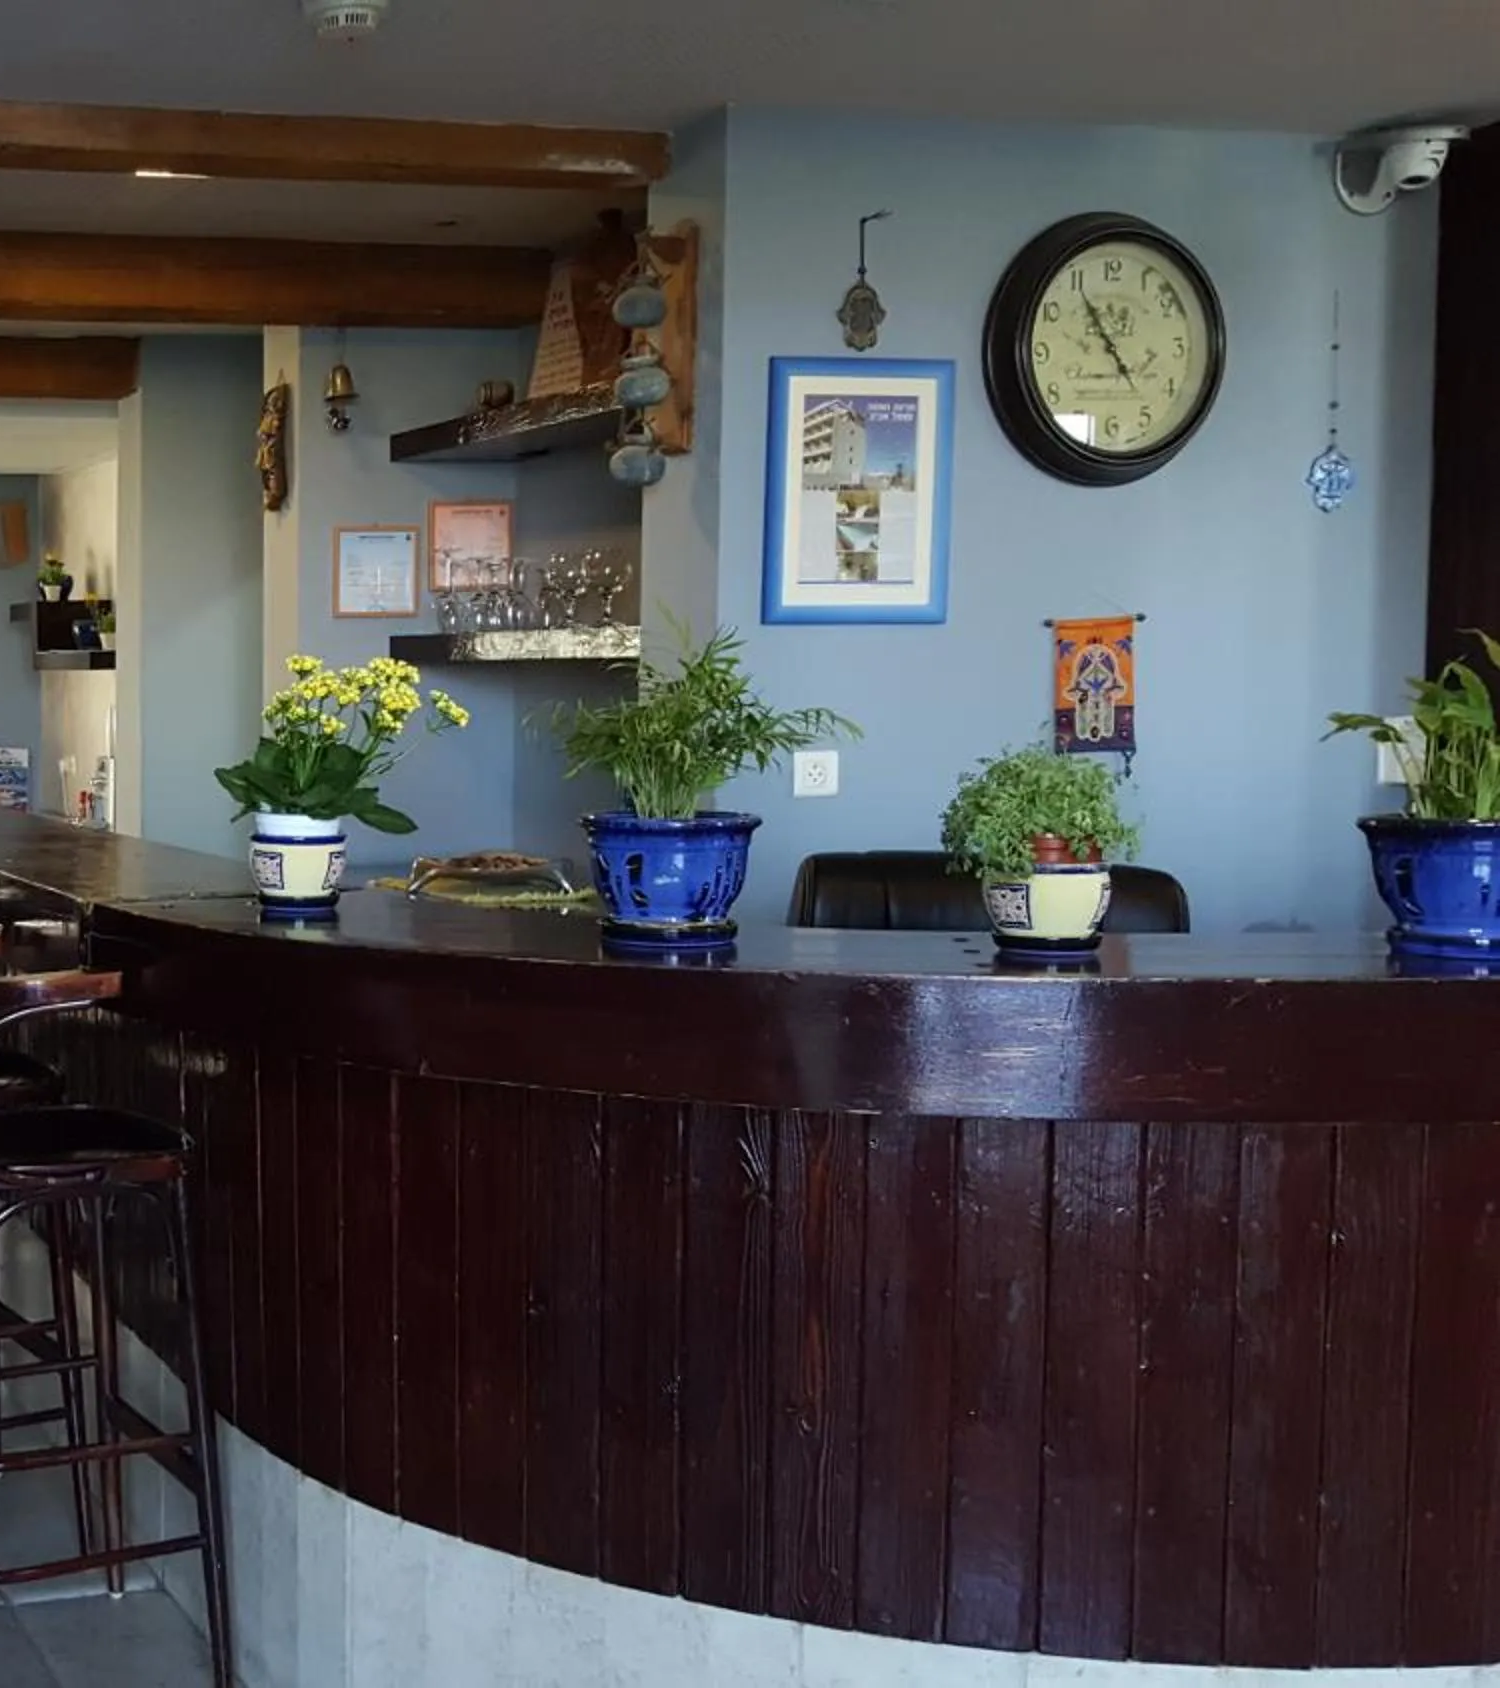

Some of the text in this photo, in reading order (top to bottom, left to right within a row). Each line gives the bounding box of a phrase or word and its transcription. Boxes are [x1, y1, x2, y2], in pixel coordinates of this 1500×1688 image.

[1071, 270, 1084, 291] 11
[1104, 259, 1123, 282] 12
[1043, 301, 1060, 323] 10
[1034, 341, 1049, 365] 9
[1172, 336, 1185, 359] 3
[1047, 382, 1060, 406] 8
[1162, 376, 1176, 398] 4
[1104, 415, 1119, 438] 6
[1138, 405, 1152, 429] 5
